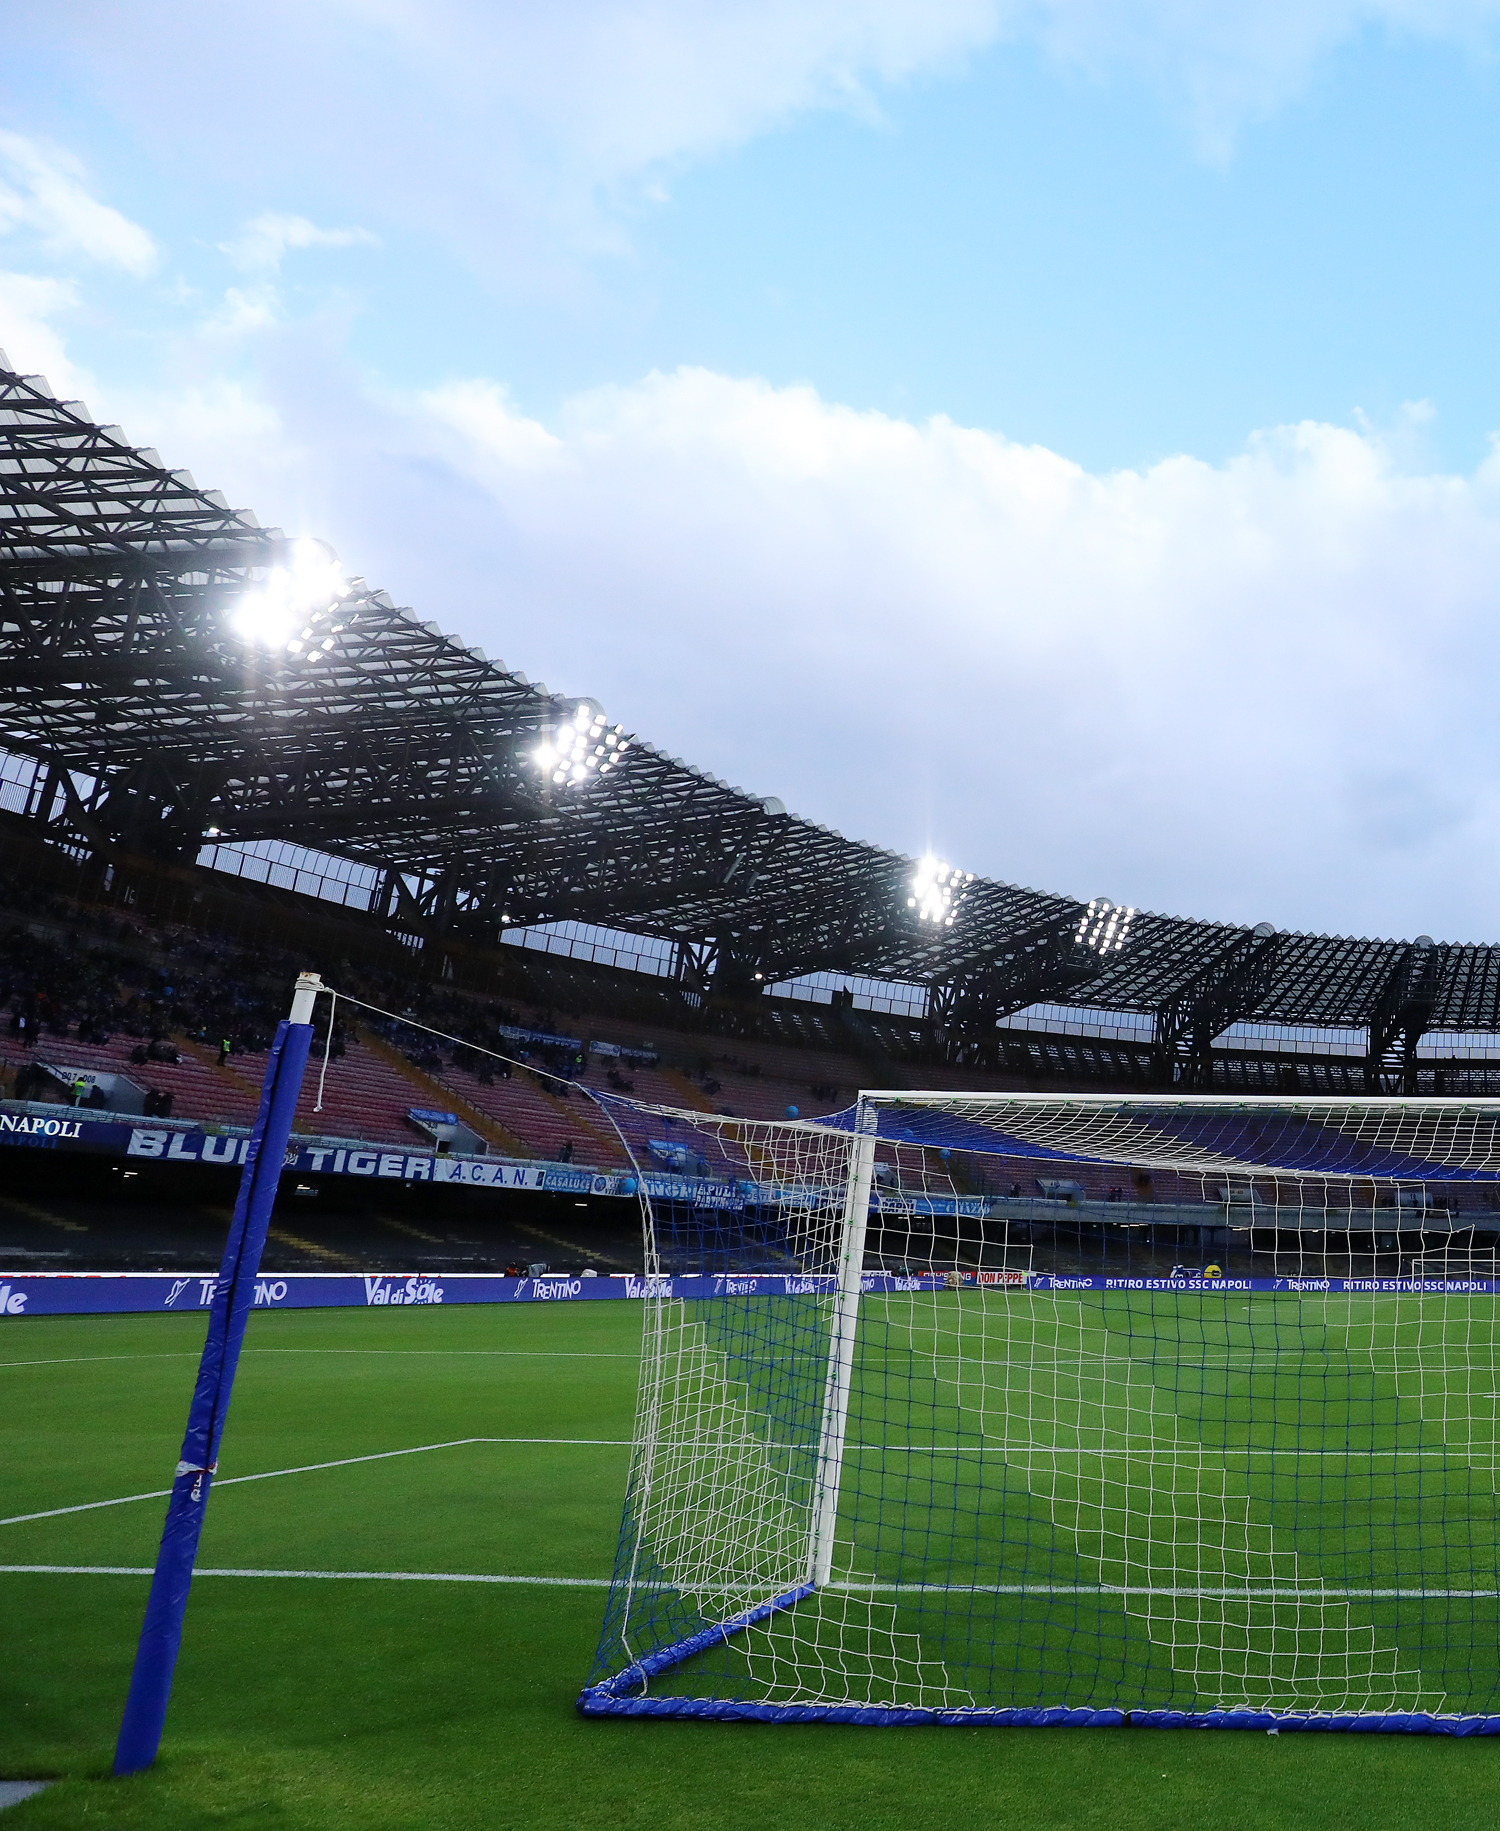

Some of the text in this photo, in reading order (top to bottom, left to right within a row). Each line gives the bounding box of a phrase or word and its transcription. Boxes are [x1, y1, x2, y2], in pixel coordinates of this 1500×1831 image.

[0, 1114, 83, 1138] NAPOLI
[306, 1147, 432, 1180] TIGER
[545, 1175, 590, 1190] CASALUCE
[978, 1272, 995, 1283] DON
[997, 1272, 1023, 1283] PEPPE
[1048, 1277, 1093, 1290] TRENTINO
[532, 1278, 581, 1300] TRENTINO
[1105, 1279, 1252, 1290] RITIRO ESTIVO SSC NAPOLI
[1287, 1279, 1330, 1291] TRENTINO
[1343, 1281, 1487, 1291] RITIRO ESTIVO SSC NAPOLI
